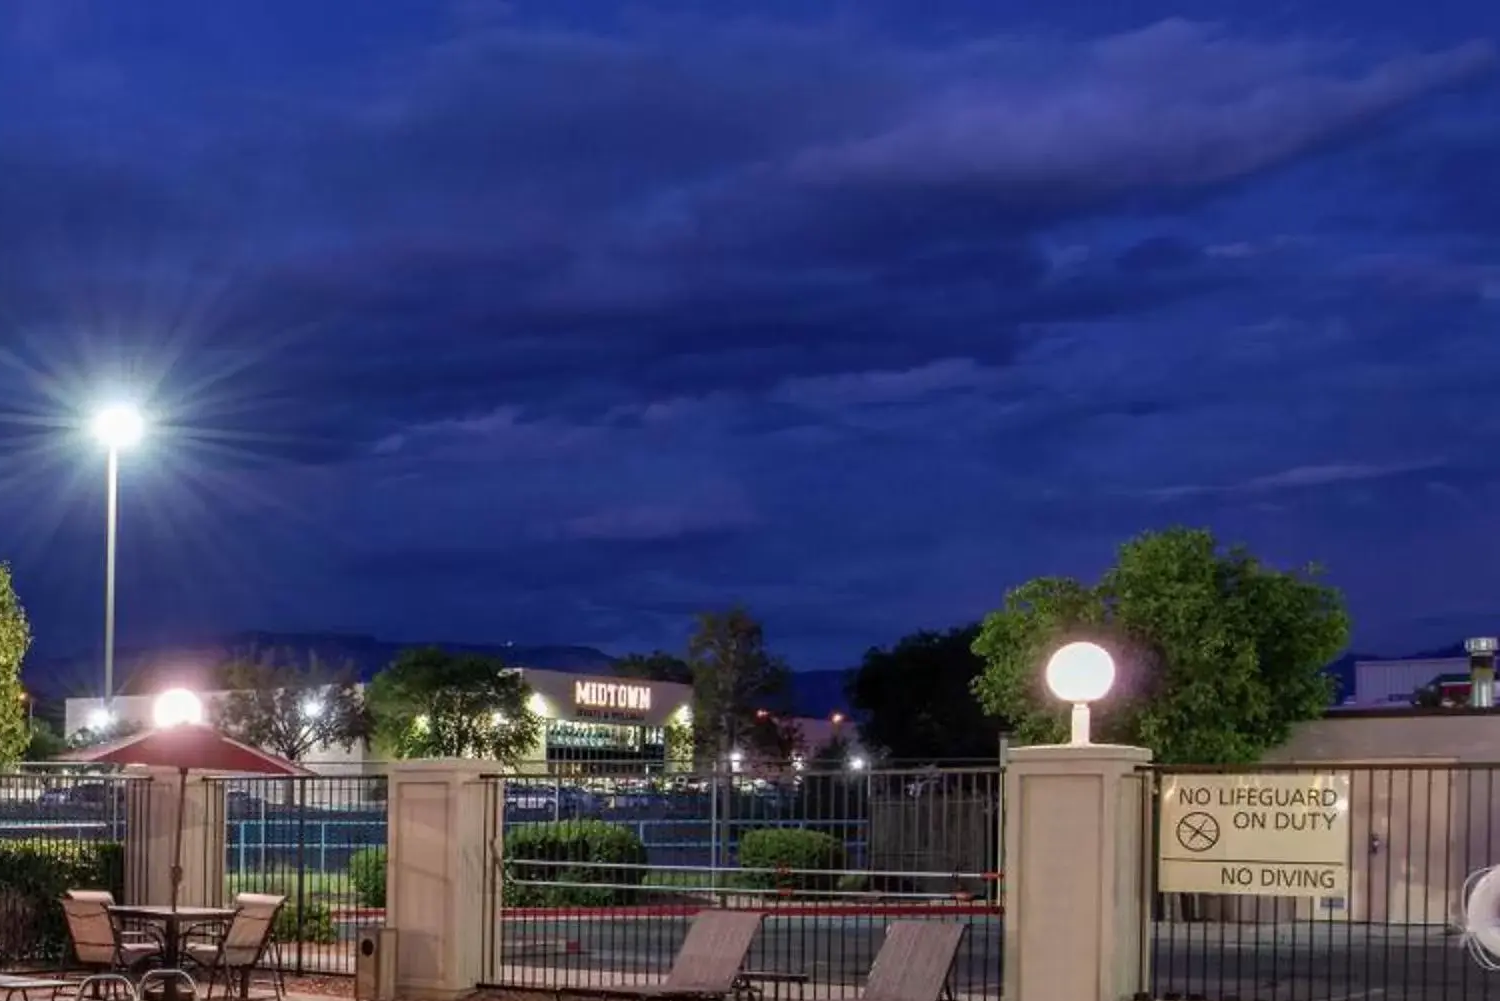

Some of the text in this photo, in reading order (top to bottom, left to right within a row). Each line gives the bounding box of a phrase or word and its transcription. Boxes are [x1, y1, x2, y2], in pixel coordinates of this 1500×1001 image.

[575, 681, 652, 709] MIDTOWN
[1179, 787, 1338, 807] NO LIFEGUARD
[1232, 811, 1338, 831] ON DUTY
[1220, 867, 1336, 889] NO DIVING
